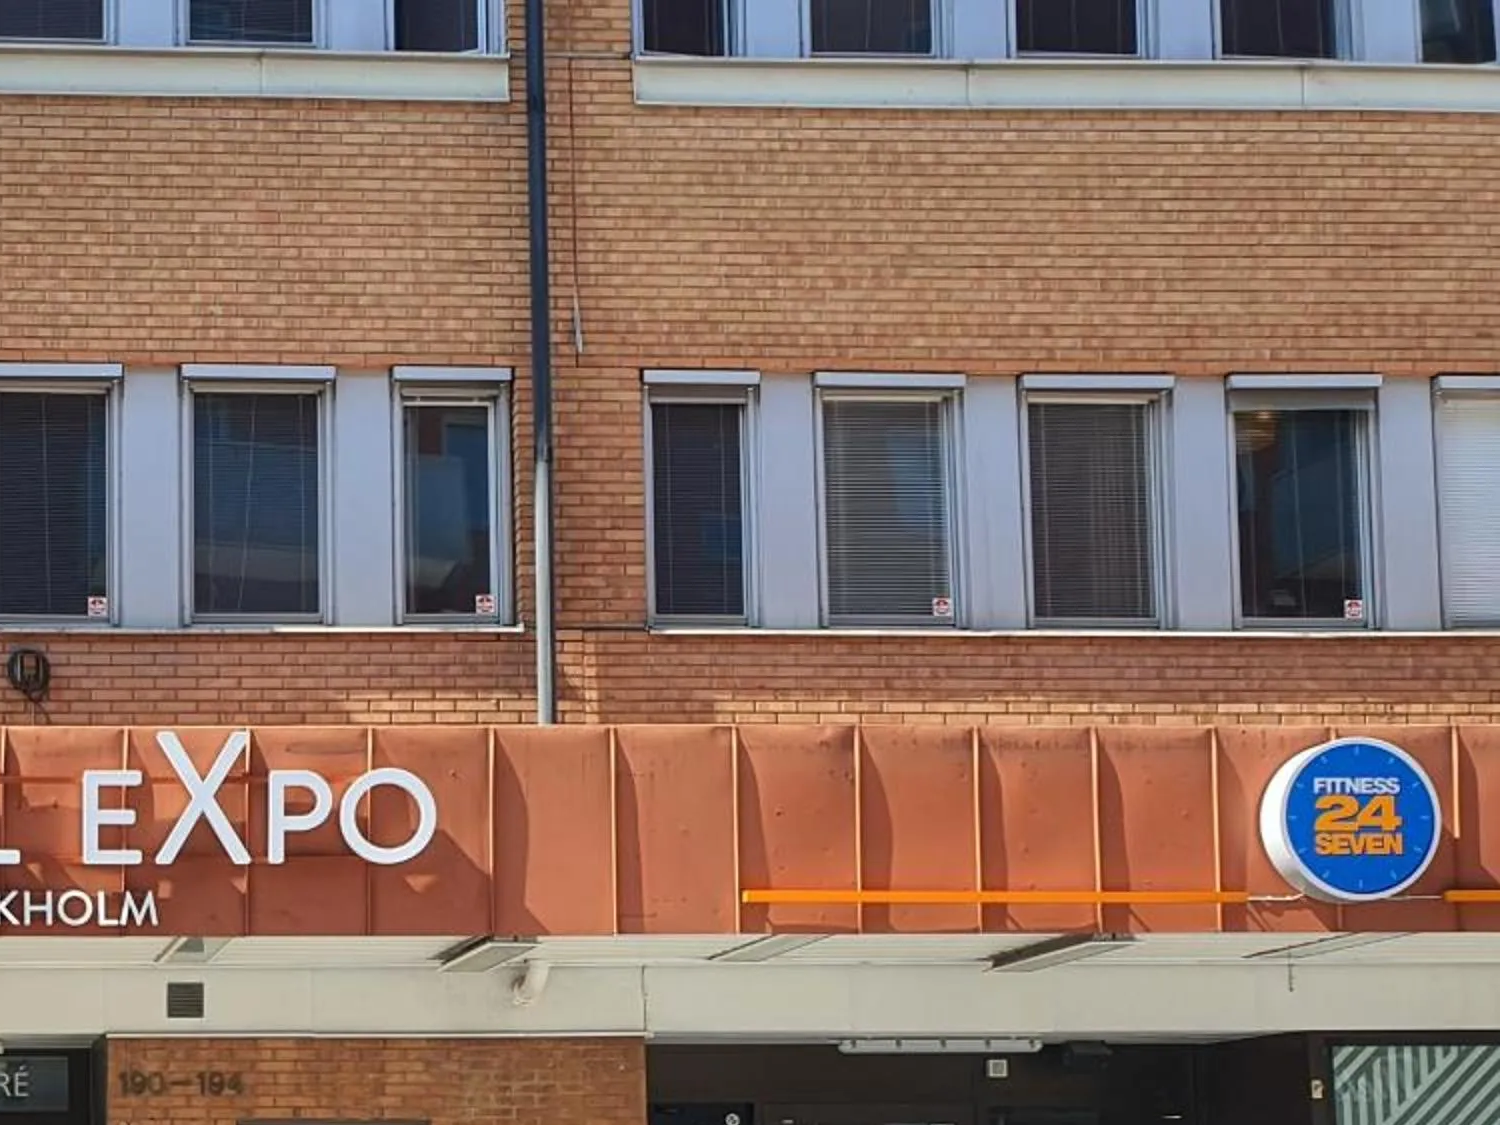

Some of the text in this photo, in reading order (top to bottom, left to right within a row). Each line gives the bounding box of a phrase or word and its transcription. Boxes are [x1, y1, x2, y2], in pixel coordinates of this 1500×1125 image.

[82, 731, 437, 866] EXPO
[1313, 777, 1400, 794] FITNESS
[1314, 795, 1403, 832] 24
[1315, 832, 1403, 855] SEVEN
